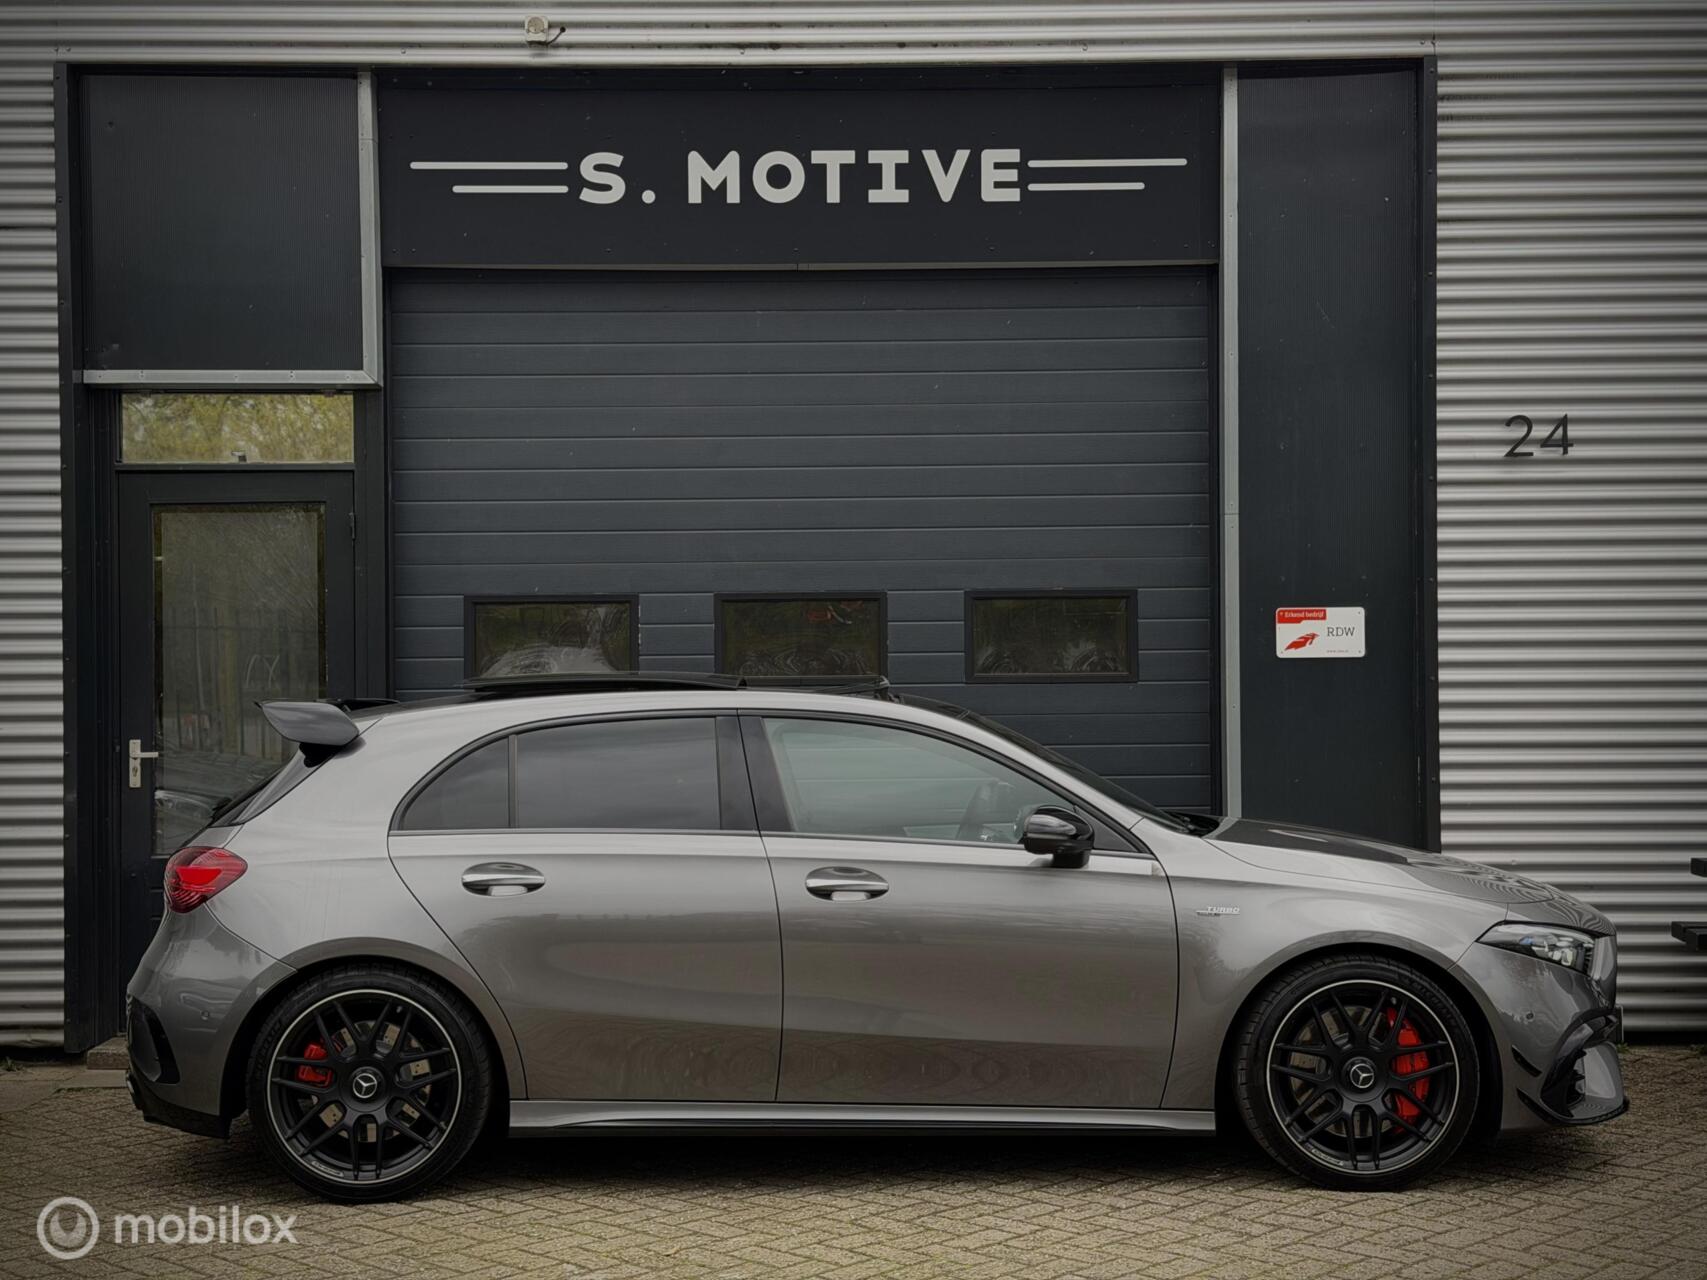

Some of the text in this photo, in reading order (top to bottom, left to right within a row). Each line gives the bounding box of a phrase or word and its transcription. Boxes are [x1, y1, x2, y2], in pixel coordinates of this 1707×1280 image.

[580, 149, 1021, 204] S. MOTIVE
[1504, 414, 1574, 457] 24
[1327, 626, 1355, 637] RDW
